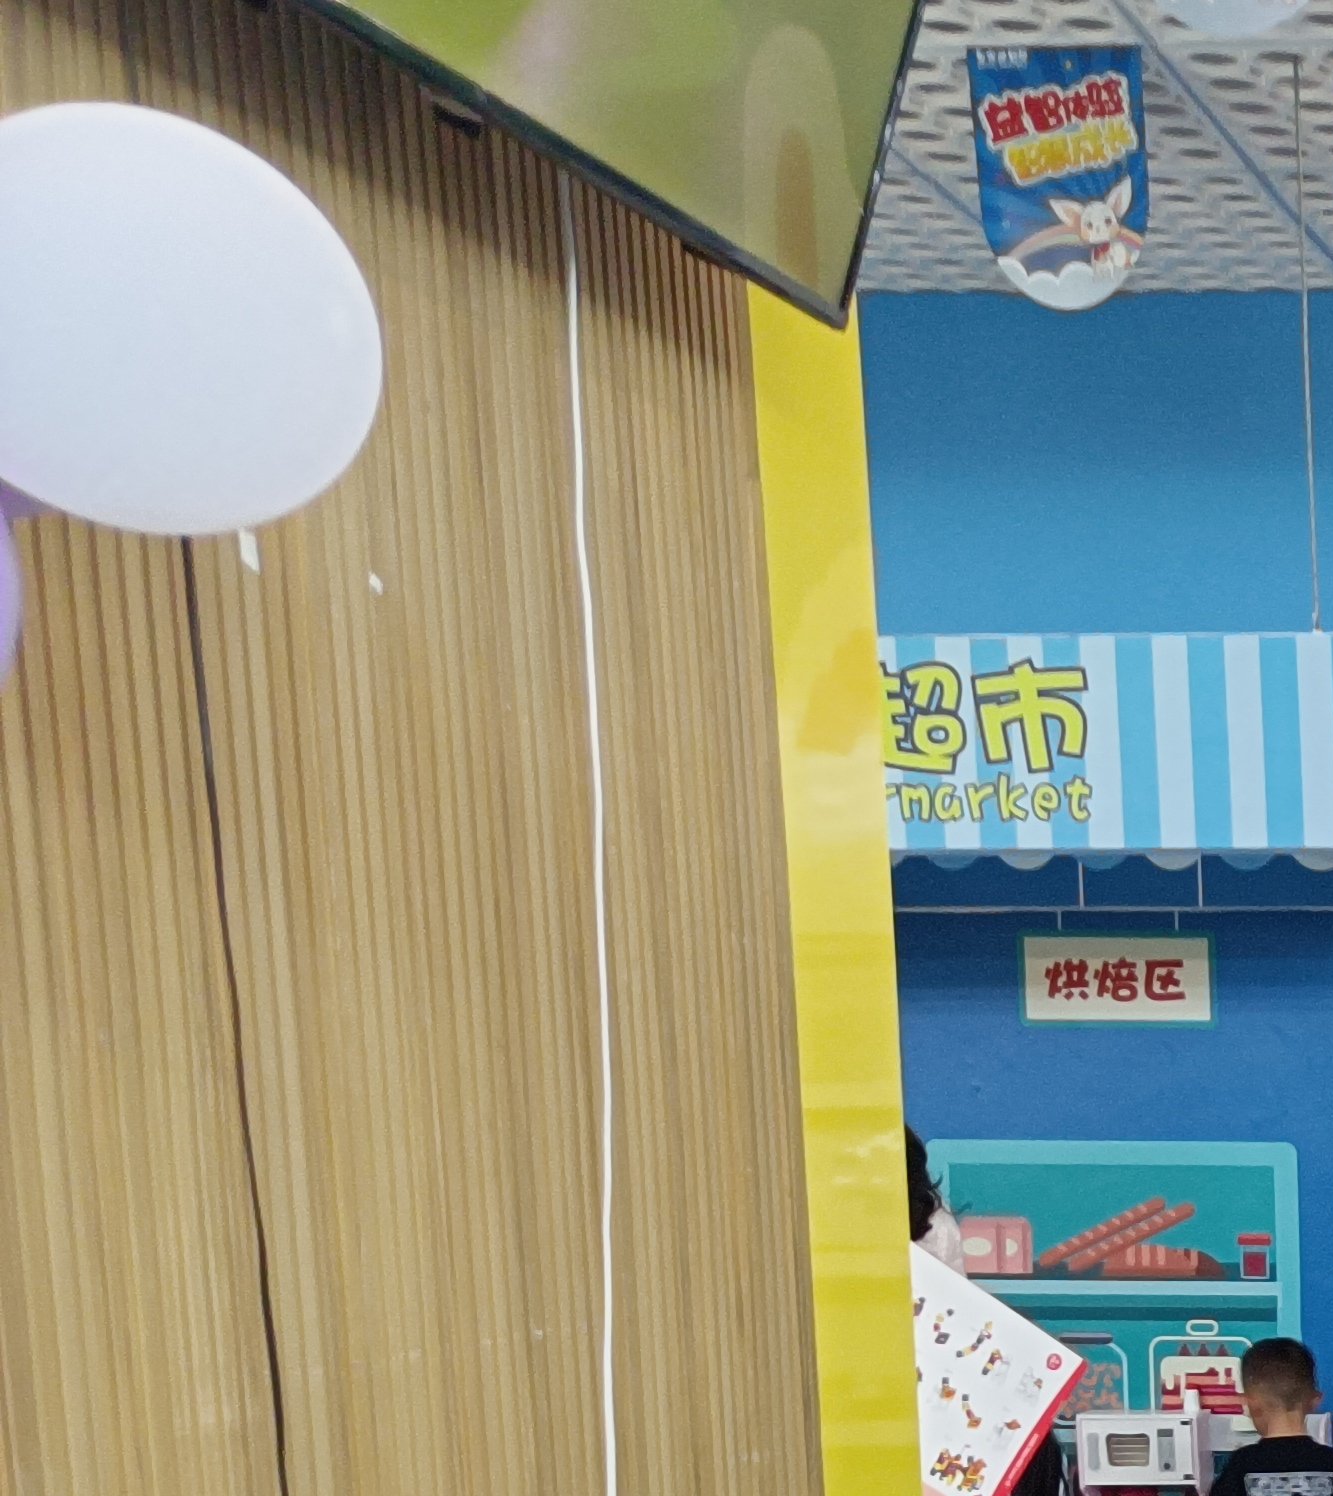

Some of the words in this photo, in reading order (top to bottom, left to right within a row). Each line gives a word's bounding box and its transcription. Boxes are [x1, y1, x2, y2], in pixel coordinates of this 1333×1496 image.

[873, 656, 1089, 775] 超市
[1044, 956, 1187, 1003] 烘焙区
